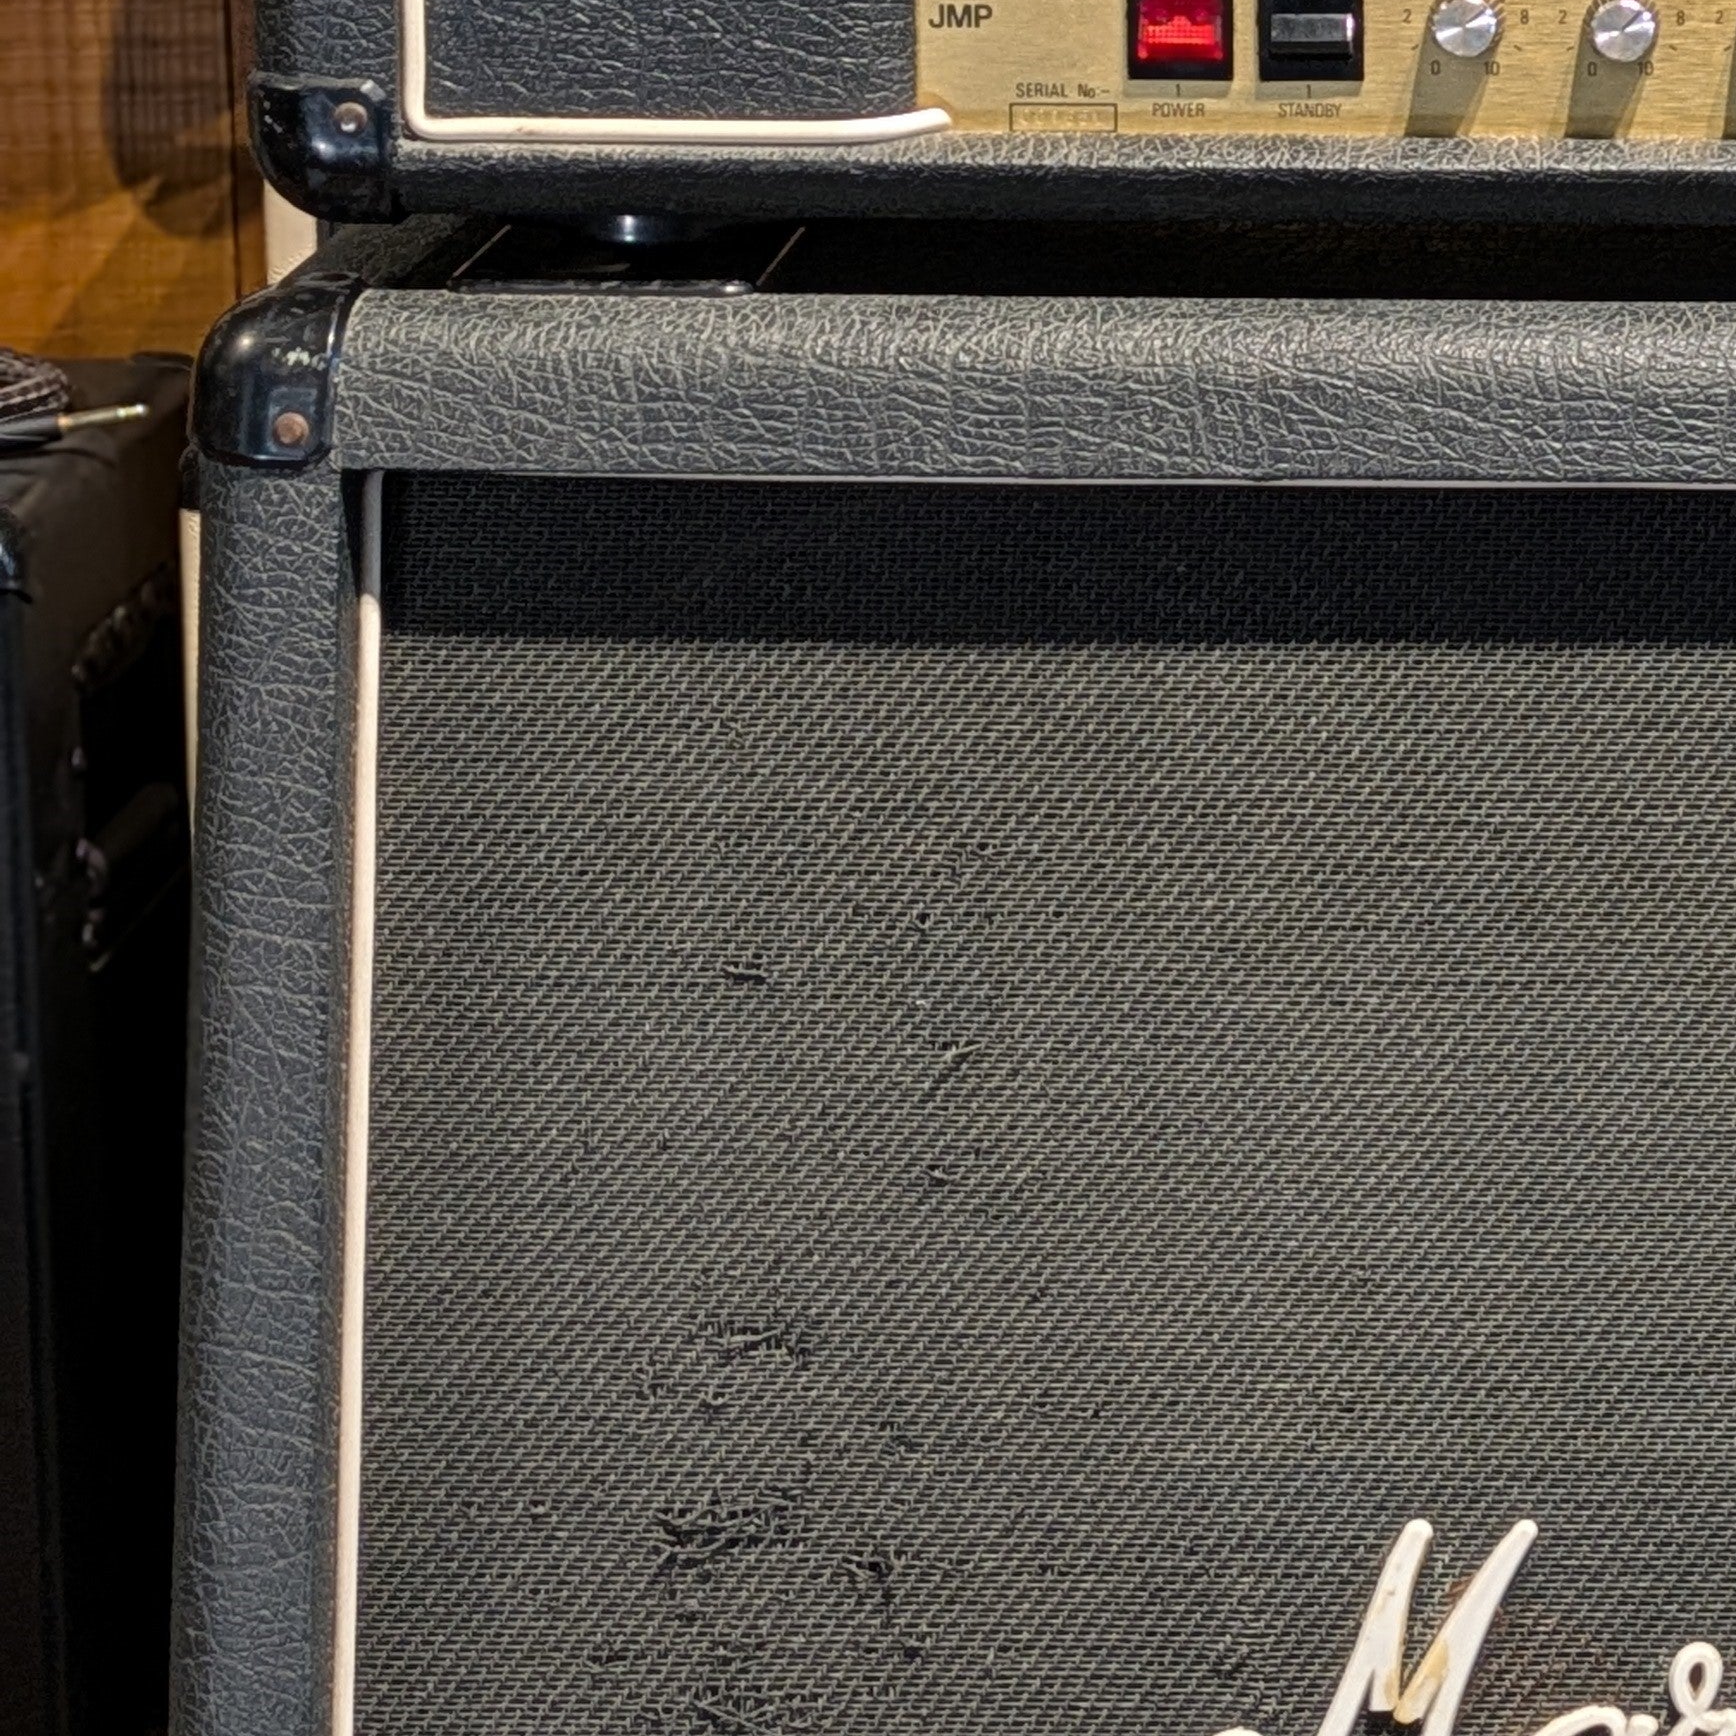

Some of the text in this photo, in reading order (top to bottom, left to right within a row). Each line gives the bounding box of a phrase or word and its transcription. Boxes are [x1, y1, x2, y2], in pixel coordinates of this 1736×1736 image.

[928, 4, 993, 29] JMP
[1402, 8, 1412, 24] 2
[1520, 9, 1529, 24] 8
[1558, 9, 1567, 24] 2
[1676, 10, 1685, 25] 8
[1715, 10, 1723, 25] 2
[1431, 60, 1441, 75] 0
[1485, 61, 1500, 76] 10
[1588, 62, 1597, 76] 0
[1639, 60, 1654, 76] 10
[1016, 83, 1067, 98] SERIAL
[1152, 102, 1205, 118] POWER
[1278, 103, 1342, 118] STANDBY
